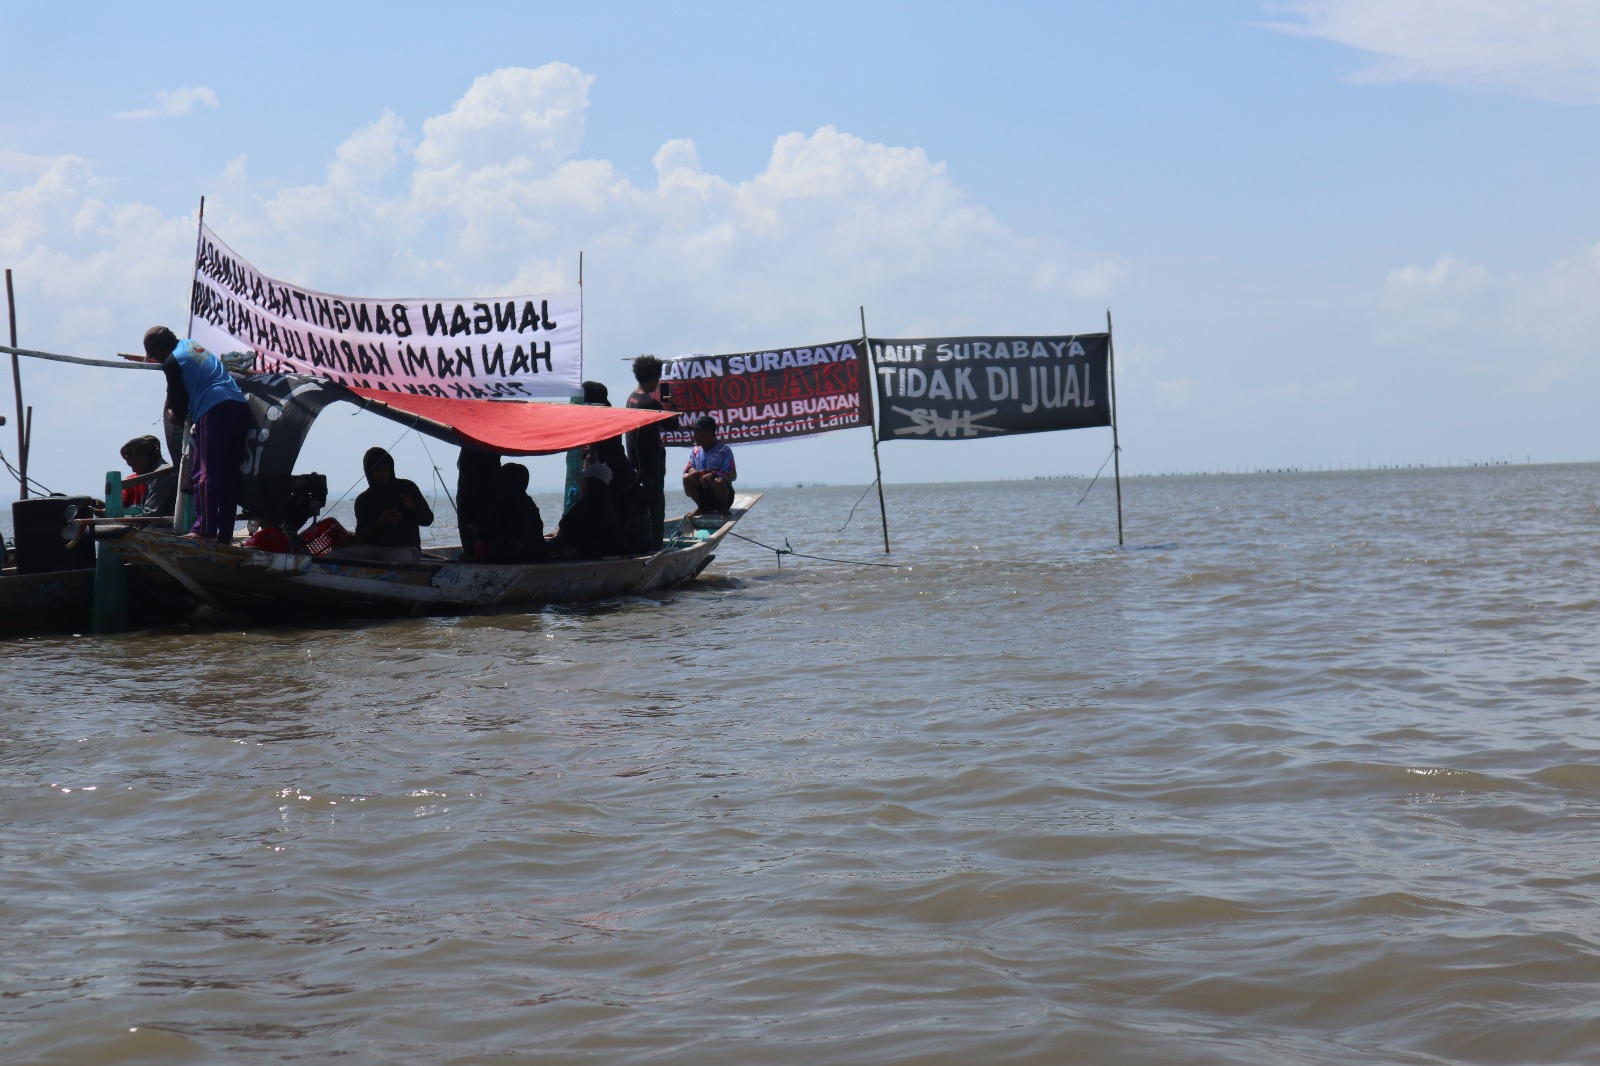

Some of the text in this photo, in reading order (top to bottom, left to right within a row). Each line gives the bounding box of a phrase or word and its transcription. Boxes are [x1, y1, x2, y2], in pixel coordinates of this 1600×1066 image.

[728, 343, 857, 375] SURABAYA
[875, 340, 1086, 363] LAUT SURABAYA
[656, 360, 859, 411] ENOLAK!
[878, 366, 978, 400] TIDAK
[727, 400, 788, 425] PULAU
[791, 392, 860, 416] BUATAN
[716, 416, 815, 441] Waterfront
[818, 409, 860, 428] Land
